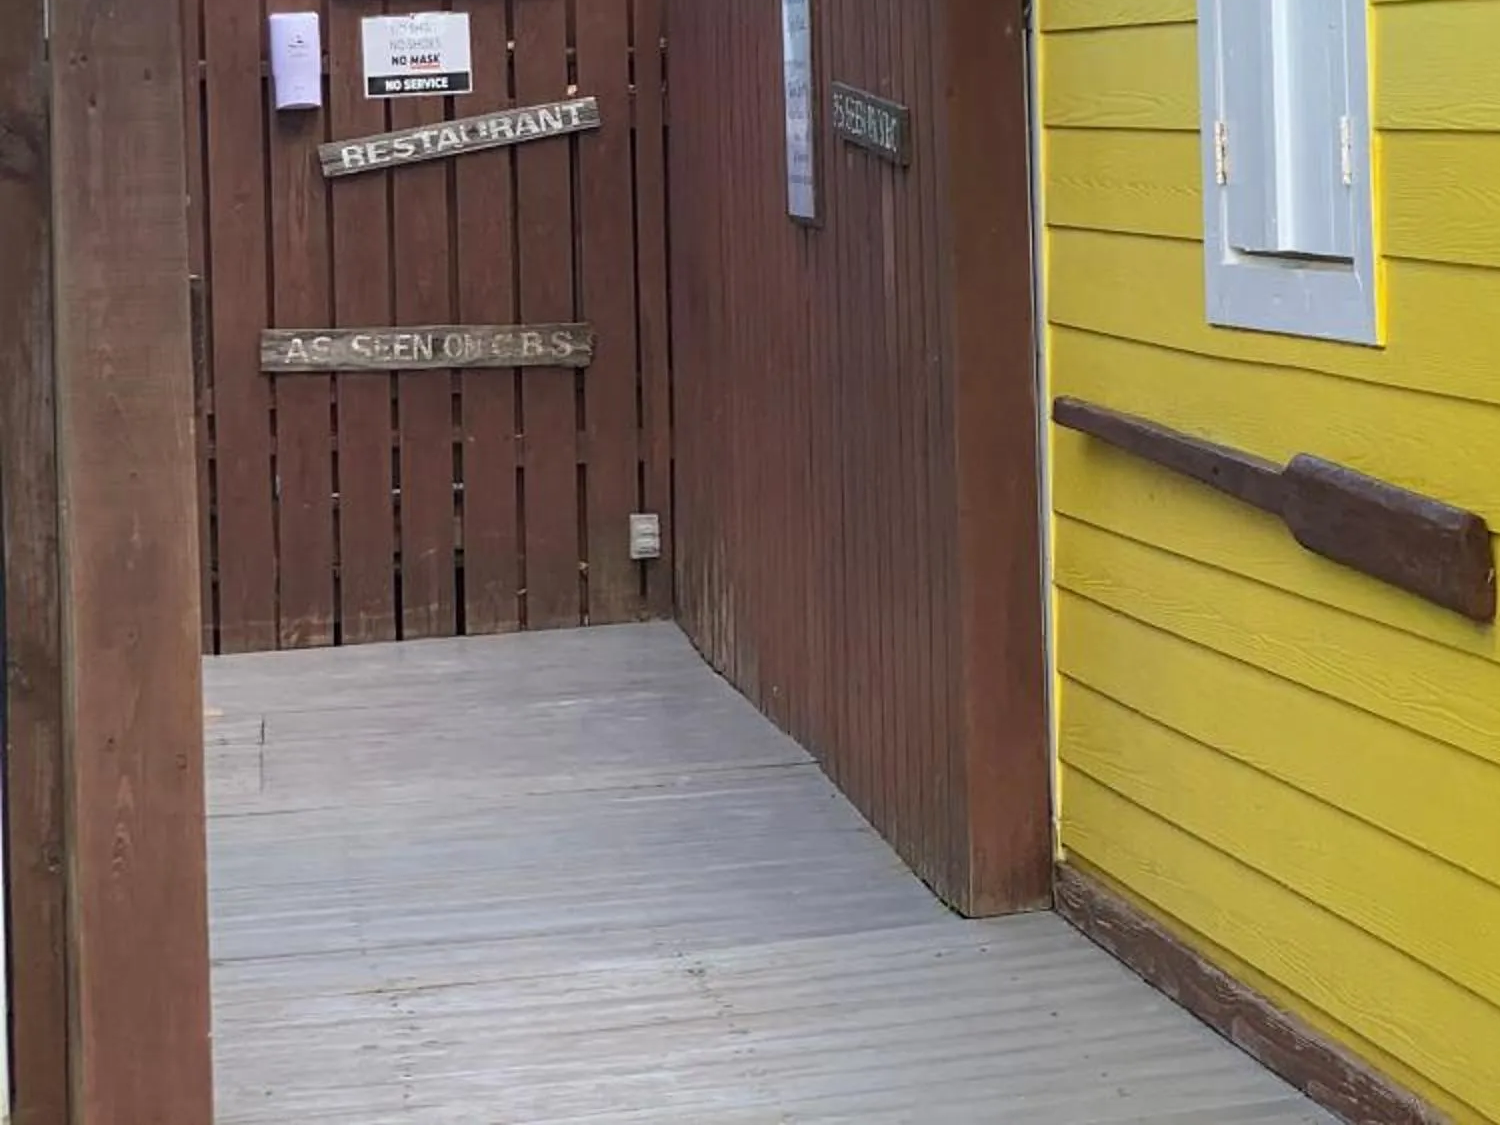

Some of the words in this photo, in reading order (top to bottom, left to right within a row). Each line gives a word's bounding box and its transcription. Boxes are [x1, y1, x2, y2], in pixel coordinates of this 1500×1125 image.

[391, 55, 408, 66] NO
[410, 53, 441, 65] MASK
[385, 79, 402, 92] NO
[404, 77, 449, 91] SERVICE
[340, 102, 584, 169] RESTAURANT
[284, 335, 333, 364] AS
